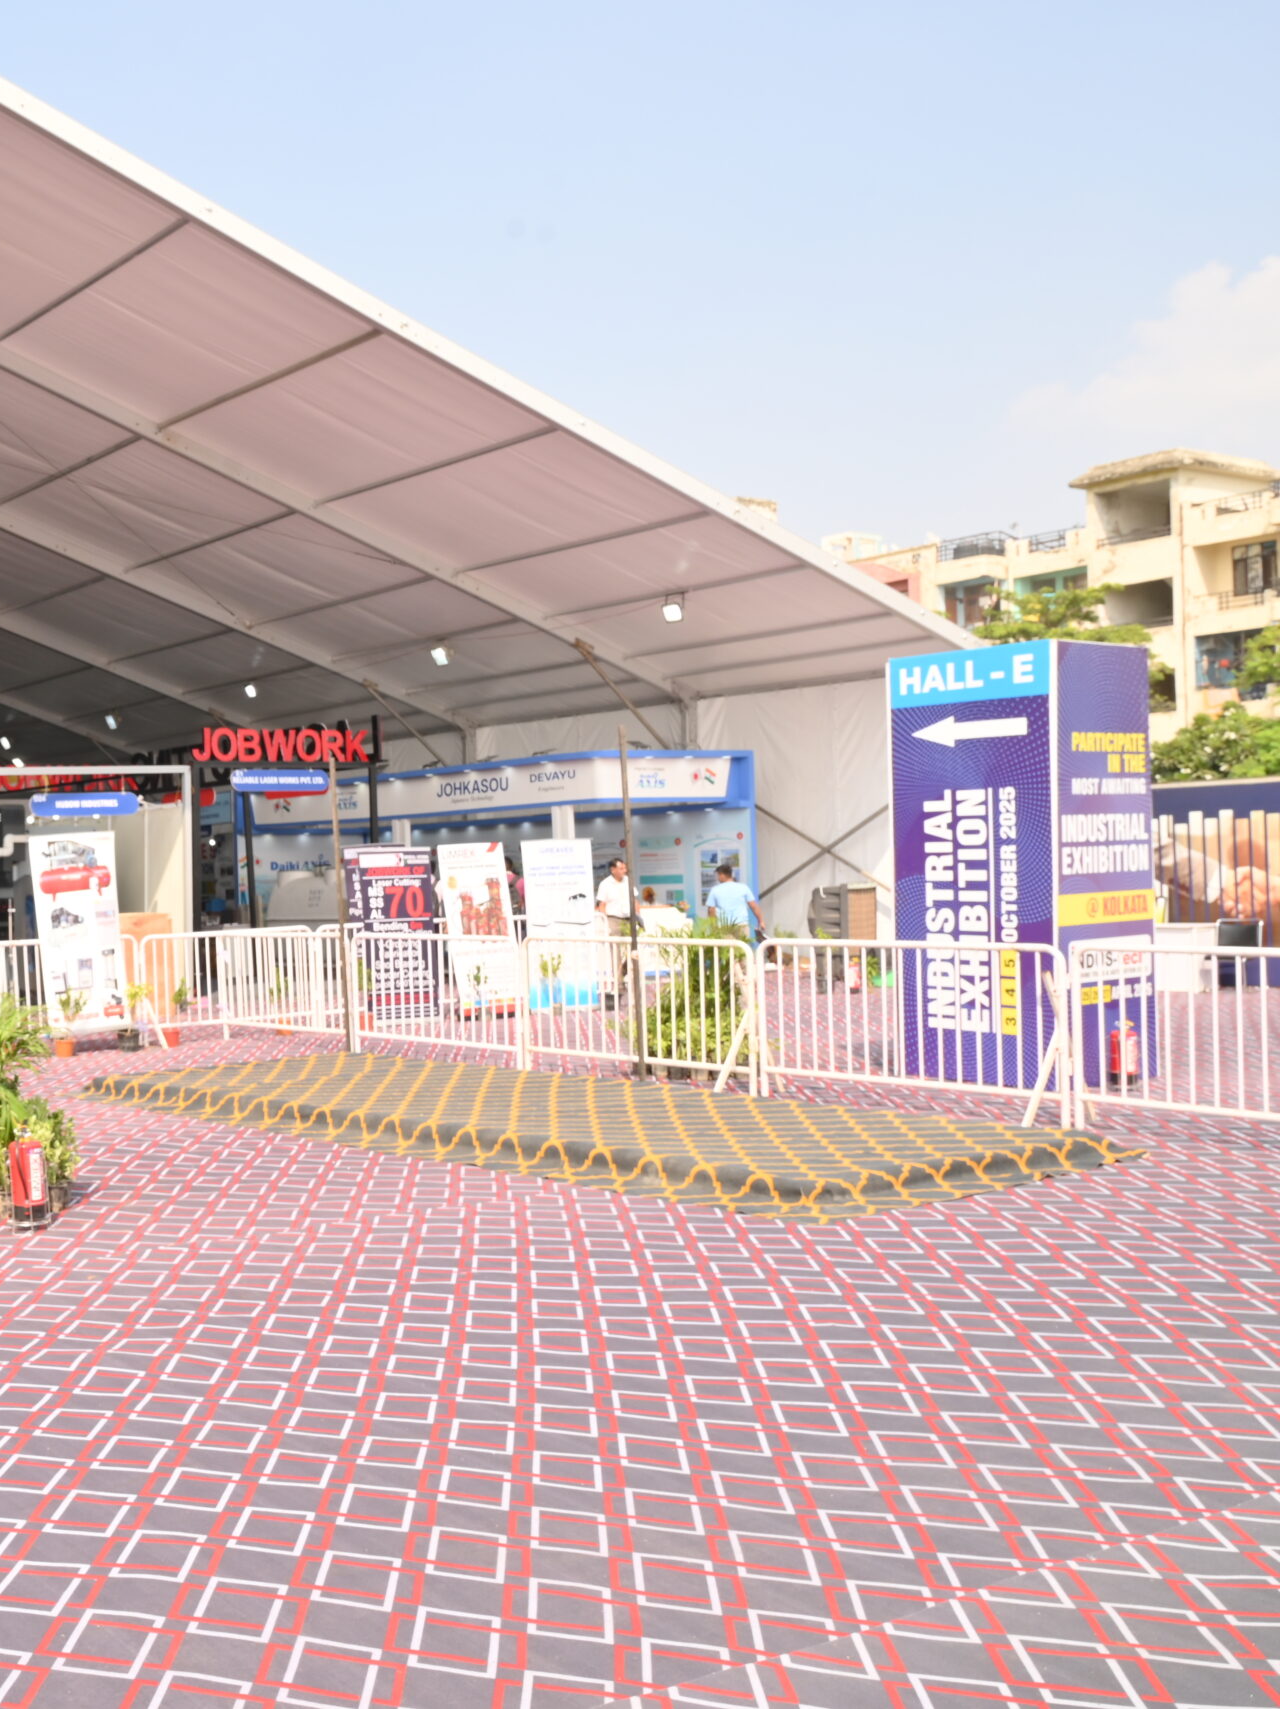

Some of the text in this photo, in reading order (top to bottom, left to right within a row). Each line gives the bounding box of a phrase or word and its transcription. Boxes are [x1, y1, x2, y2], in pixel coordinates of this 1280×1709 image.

[899, 660, 984, 696] HALL
[1013, 653, 1034, 684] E
[192, 727, 369, 763] JOBWORK
[1072, 732, 1146, 752] PARTICIPATE
[1108, 754, 1146, 773] IN THE
[529, 770, 576, 783] DEVAYU
[1072, 777, 1098, 795] MOST
[437, 777, 509, 798] JOHKASOU
[1061, 813, 1149, 843] INDUSTRIAL
[271, 861, 300, 871] Daiki
[1062, 844, 1150, 875] EXHIBITION
[368, 887, 384, 897] MS
[370, 898, 384, 908] SS
[999, 786, 1018, 1026] 3 4 5 OCTOBER 2025
[1102, 895, 1149, 916] KOLKATA
